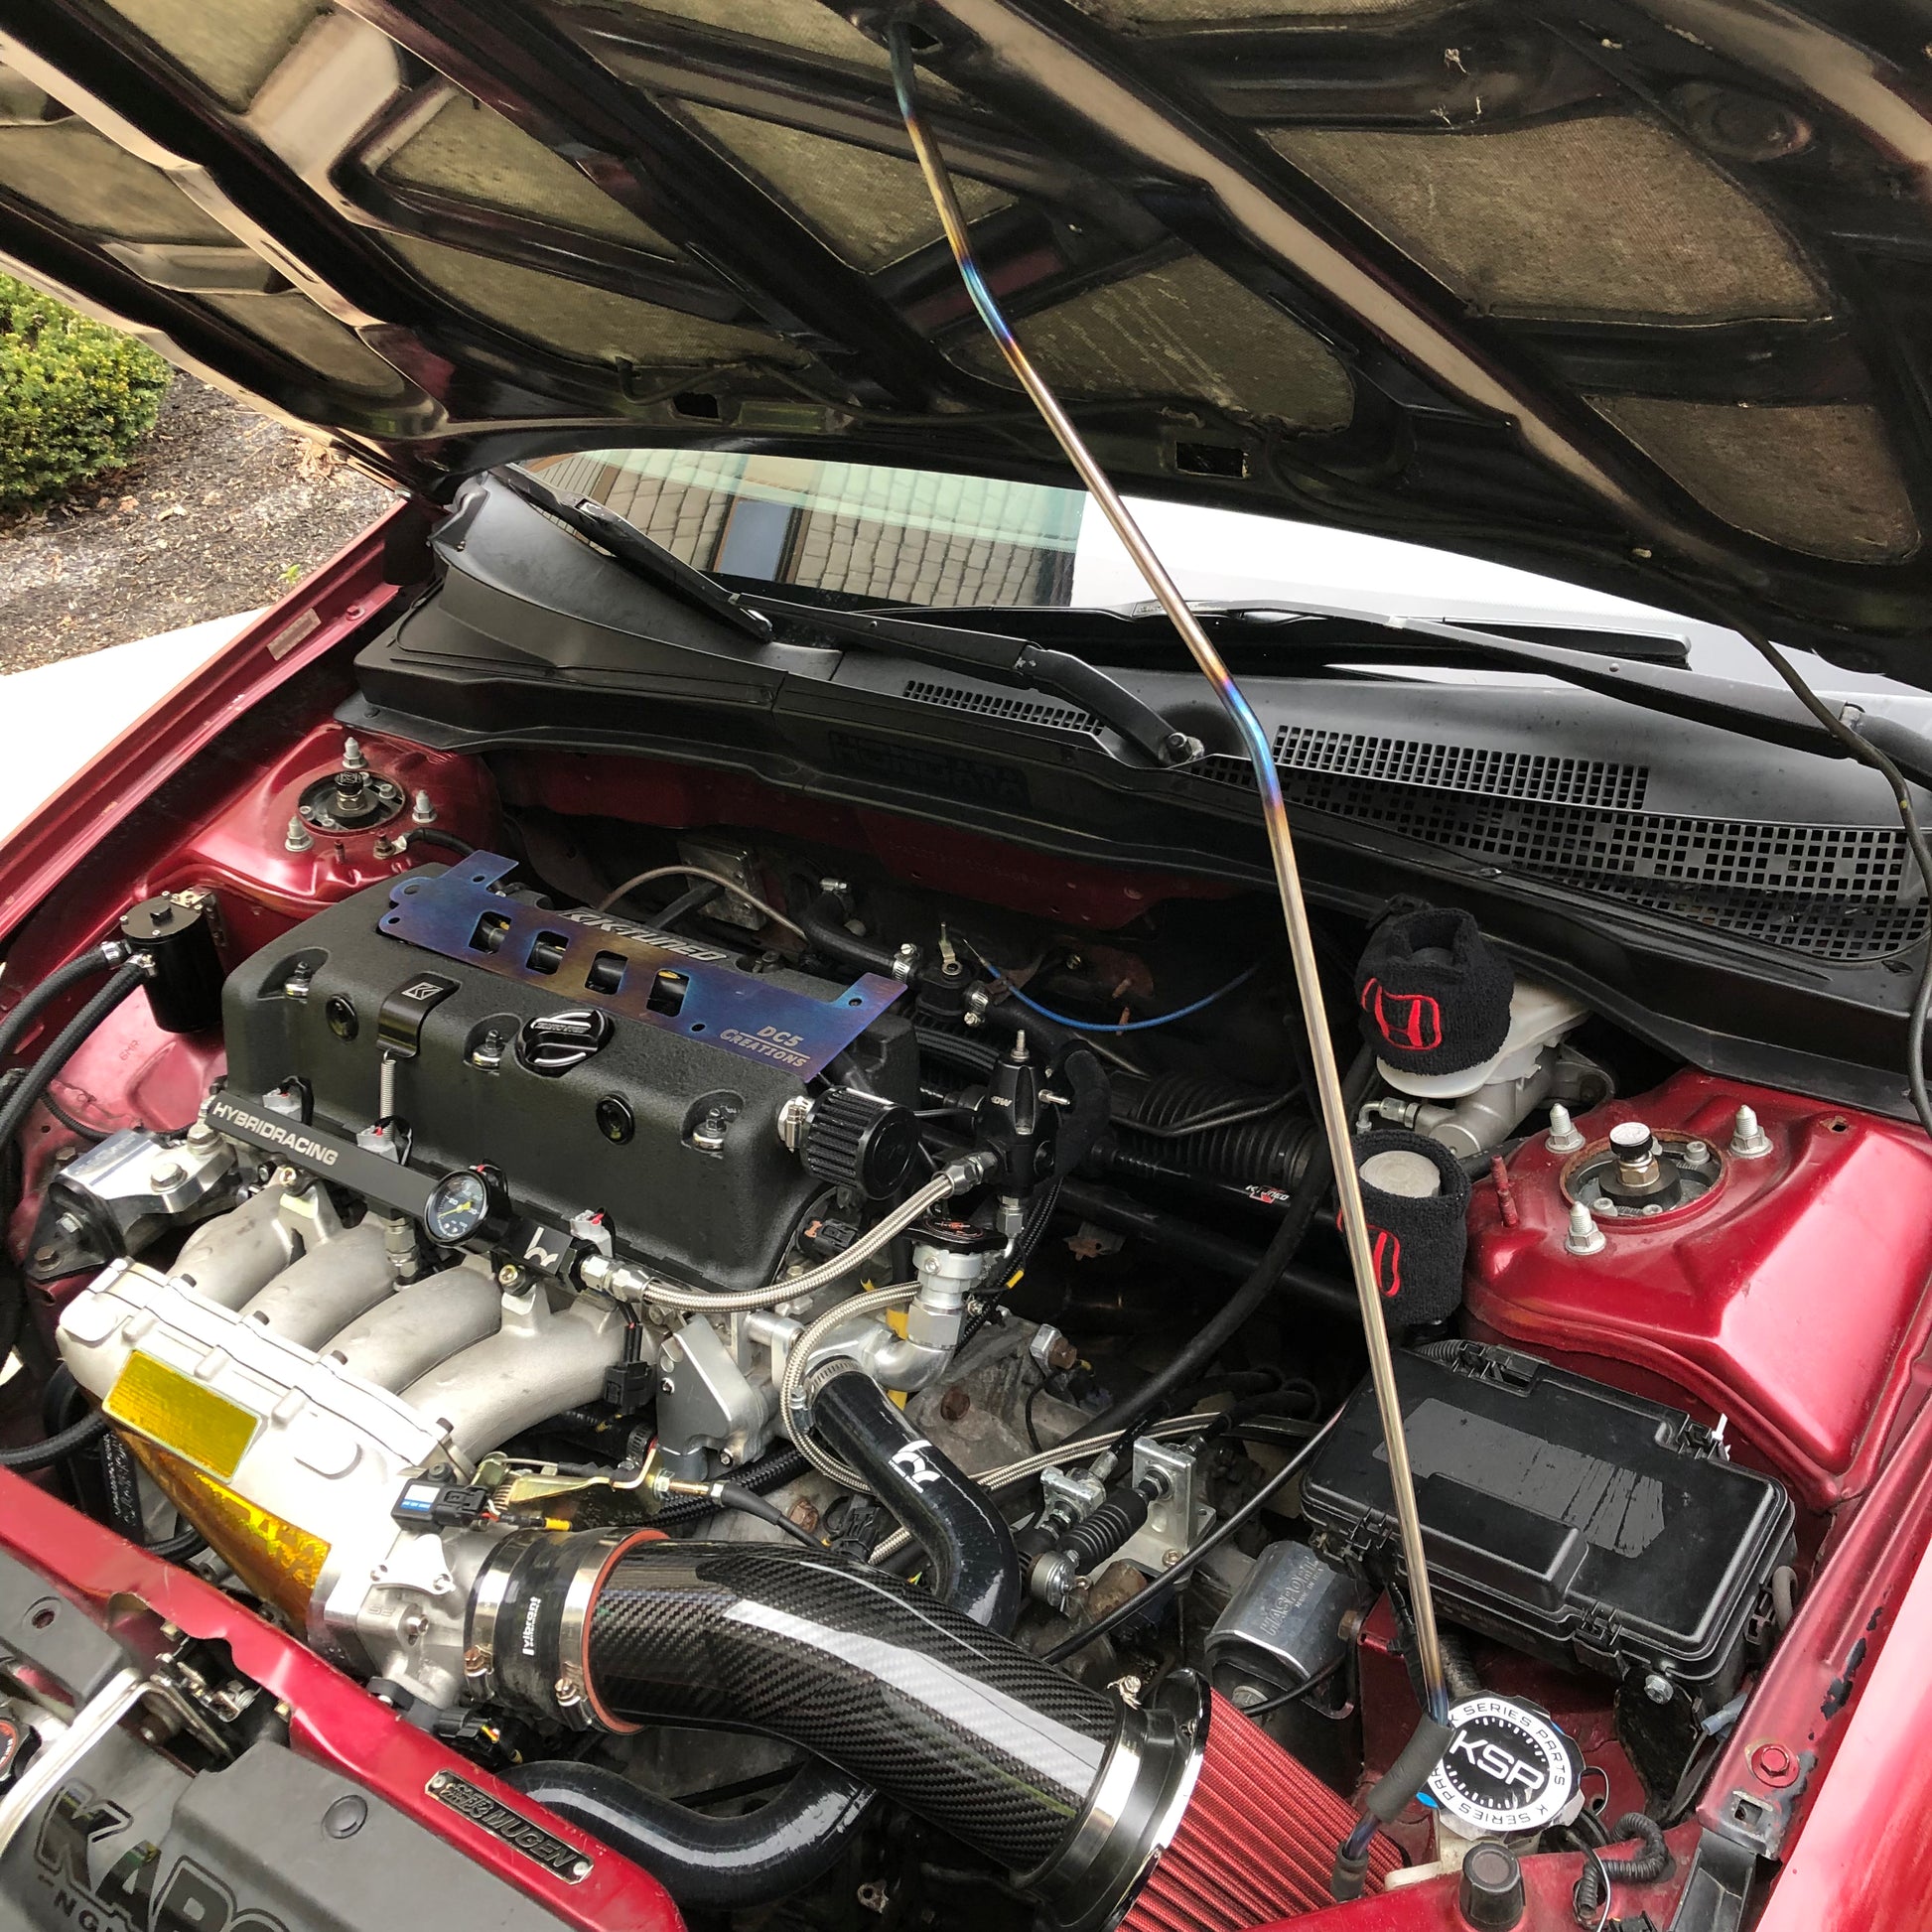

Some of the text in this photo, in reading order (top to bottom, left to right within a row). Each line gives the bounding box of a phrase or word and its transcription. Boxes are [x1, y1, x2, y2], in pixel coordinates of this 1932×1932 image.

[757, 1026, 804, 1046] DC5
[212, 1102, 339, 1166] HYBRIDRACING
[1449, 1729, 1545, 1790] KSP
[1463, 1703, 1532, 1727] SERIES
[1536, 1730, 1566, 1786] PARTS
[482, 1808, 578, 1867] MUGEN
[1458, 1802, 1532, 1826] SERIES
[1536, 1804, 1549, 1816] K
